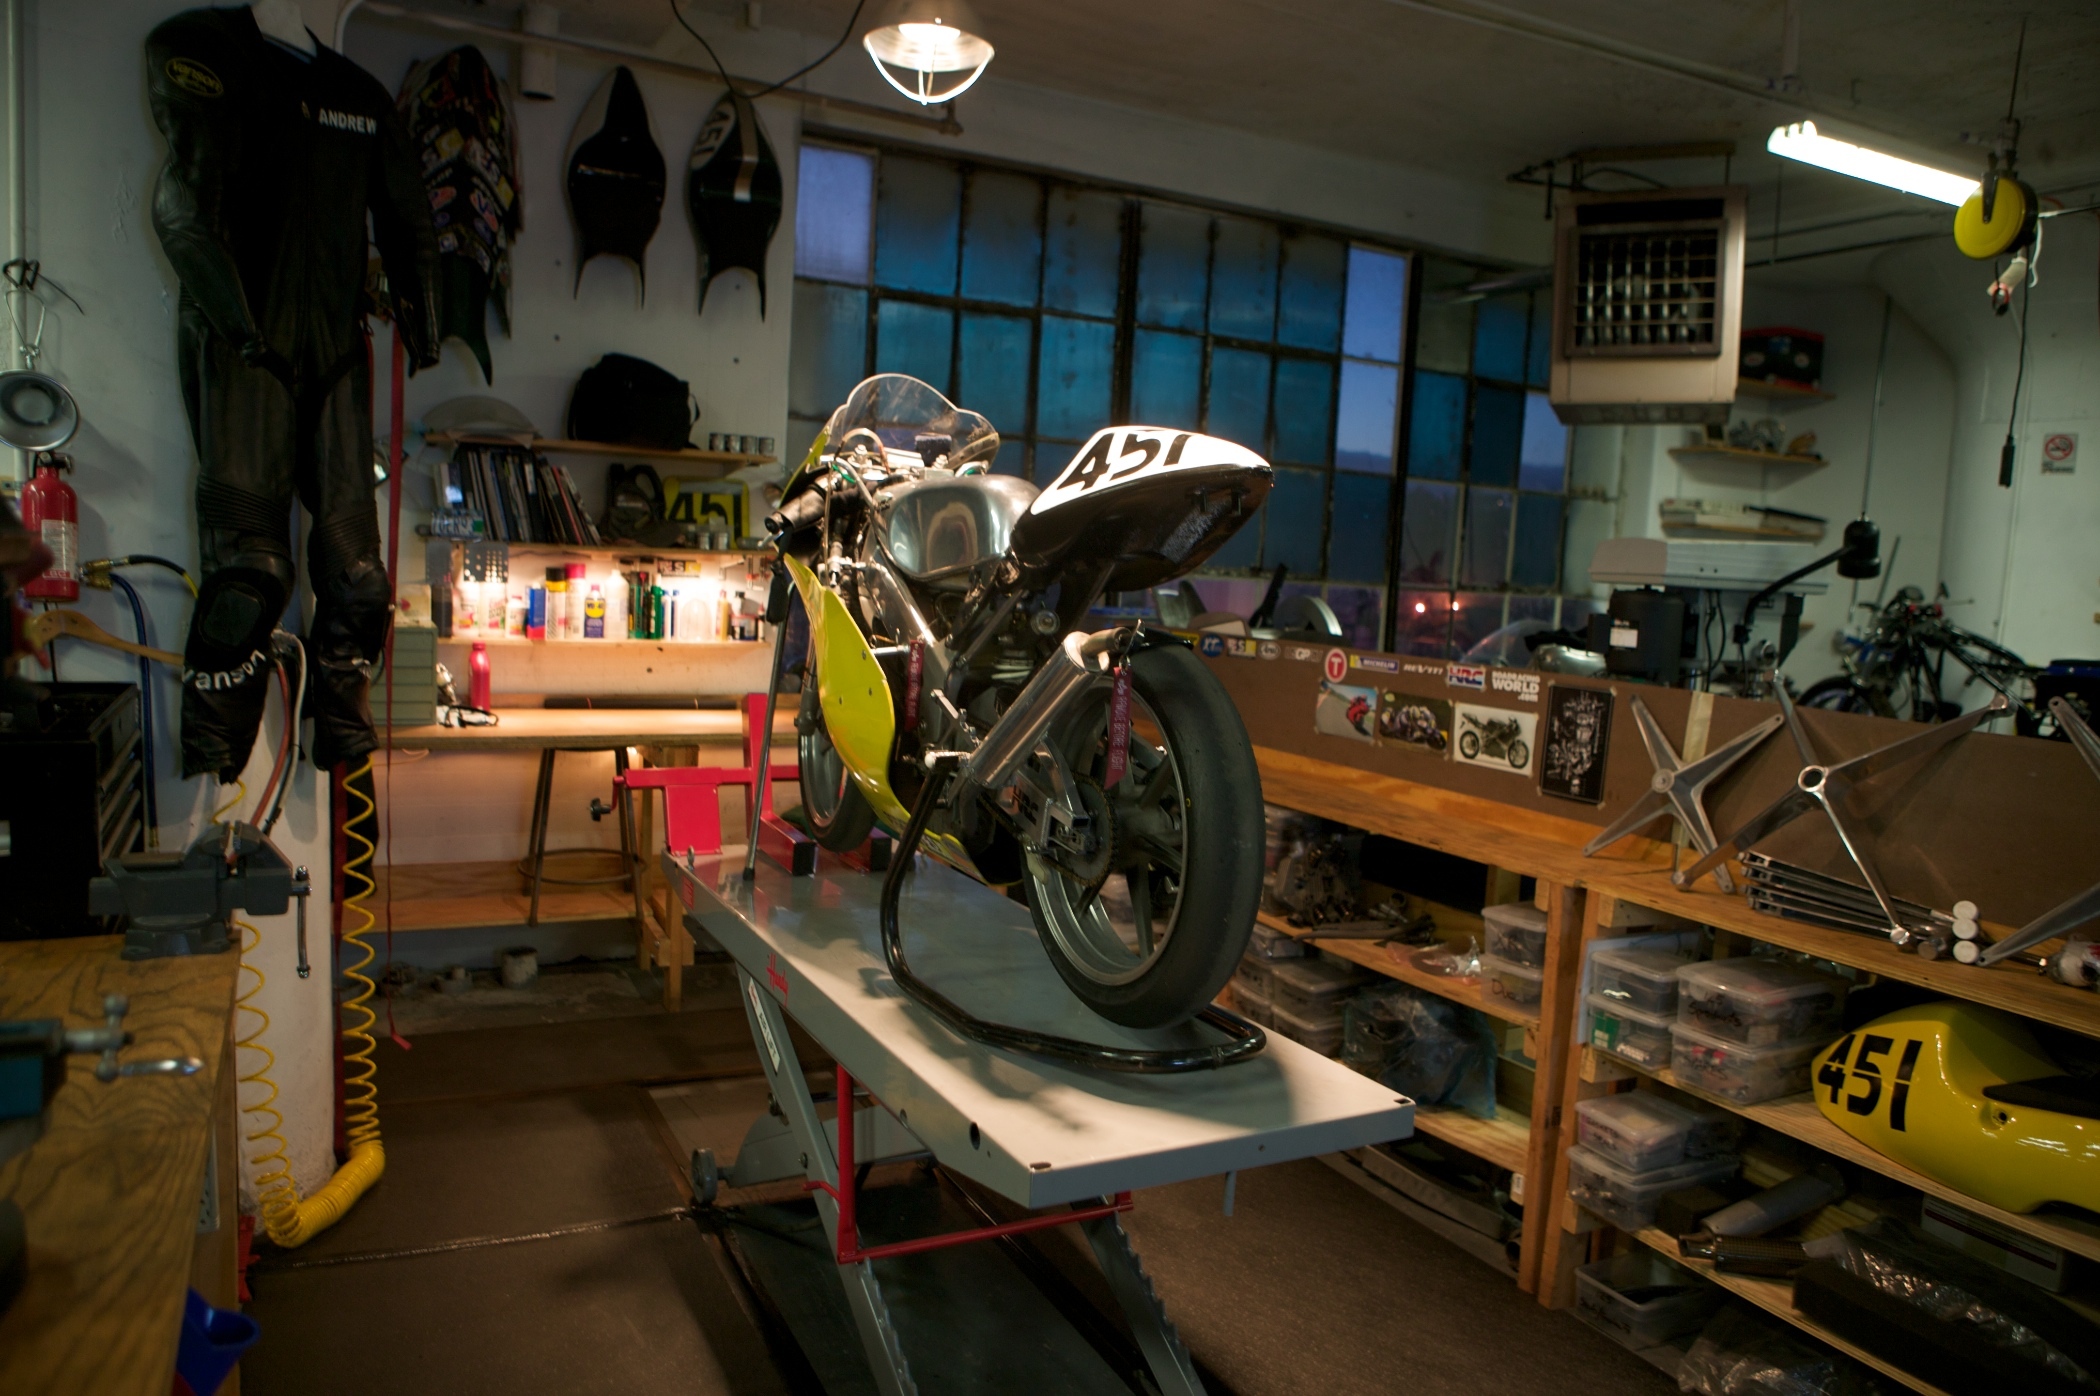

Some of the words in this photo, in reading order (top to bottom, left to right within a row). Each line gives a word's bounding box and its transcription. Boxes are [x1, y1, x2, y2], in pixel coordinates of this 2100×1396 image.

[318, 107, 378, 135] ANDREW
[1057, 431, 1191, 491] 451
[182, 648, 267, 691] vanson
[1363, 658, 1396, 670] MICHELIN
[1449, 666, 1484, 686] HRC
[1491, 670, 1541, 683] ROADRACING
[1491, 678, 1540, 694] WORLD
[1112, 722, 1126, 747] BEFORE
[1111, 749, 1124, 771] FLIGHT
[1819, 1034, 1923, 1132] 451
